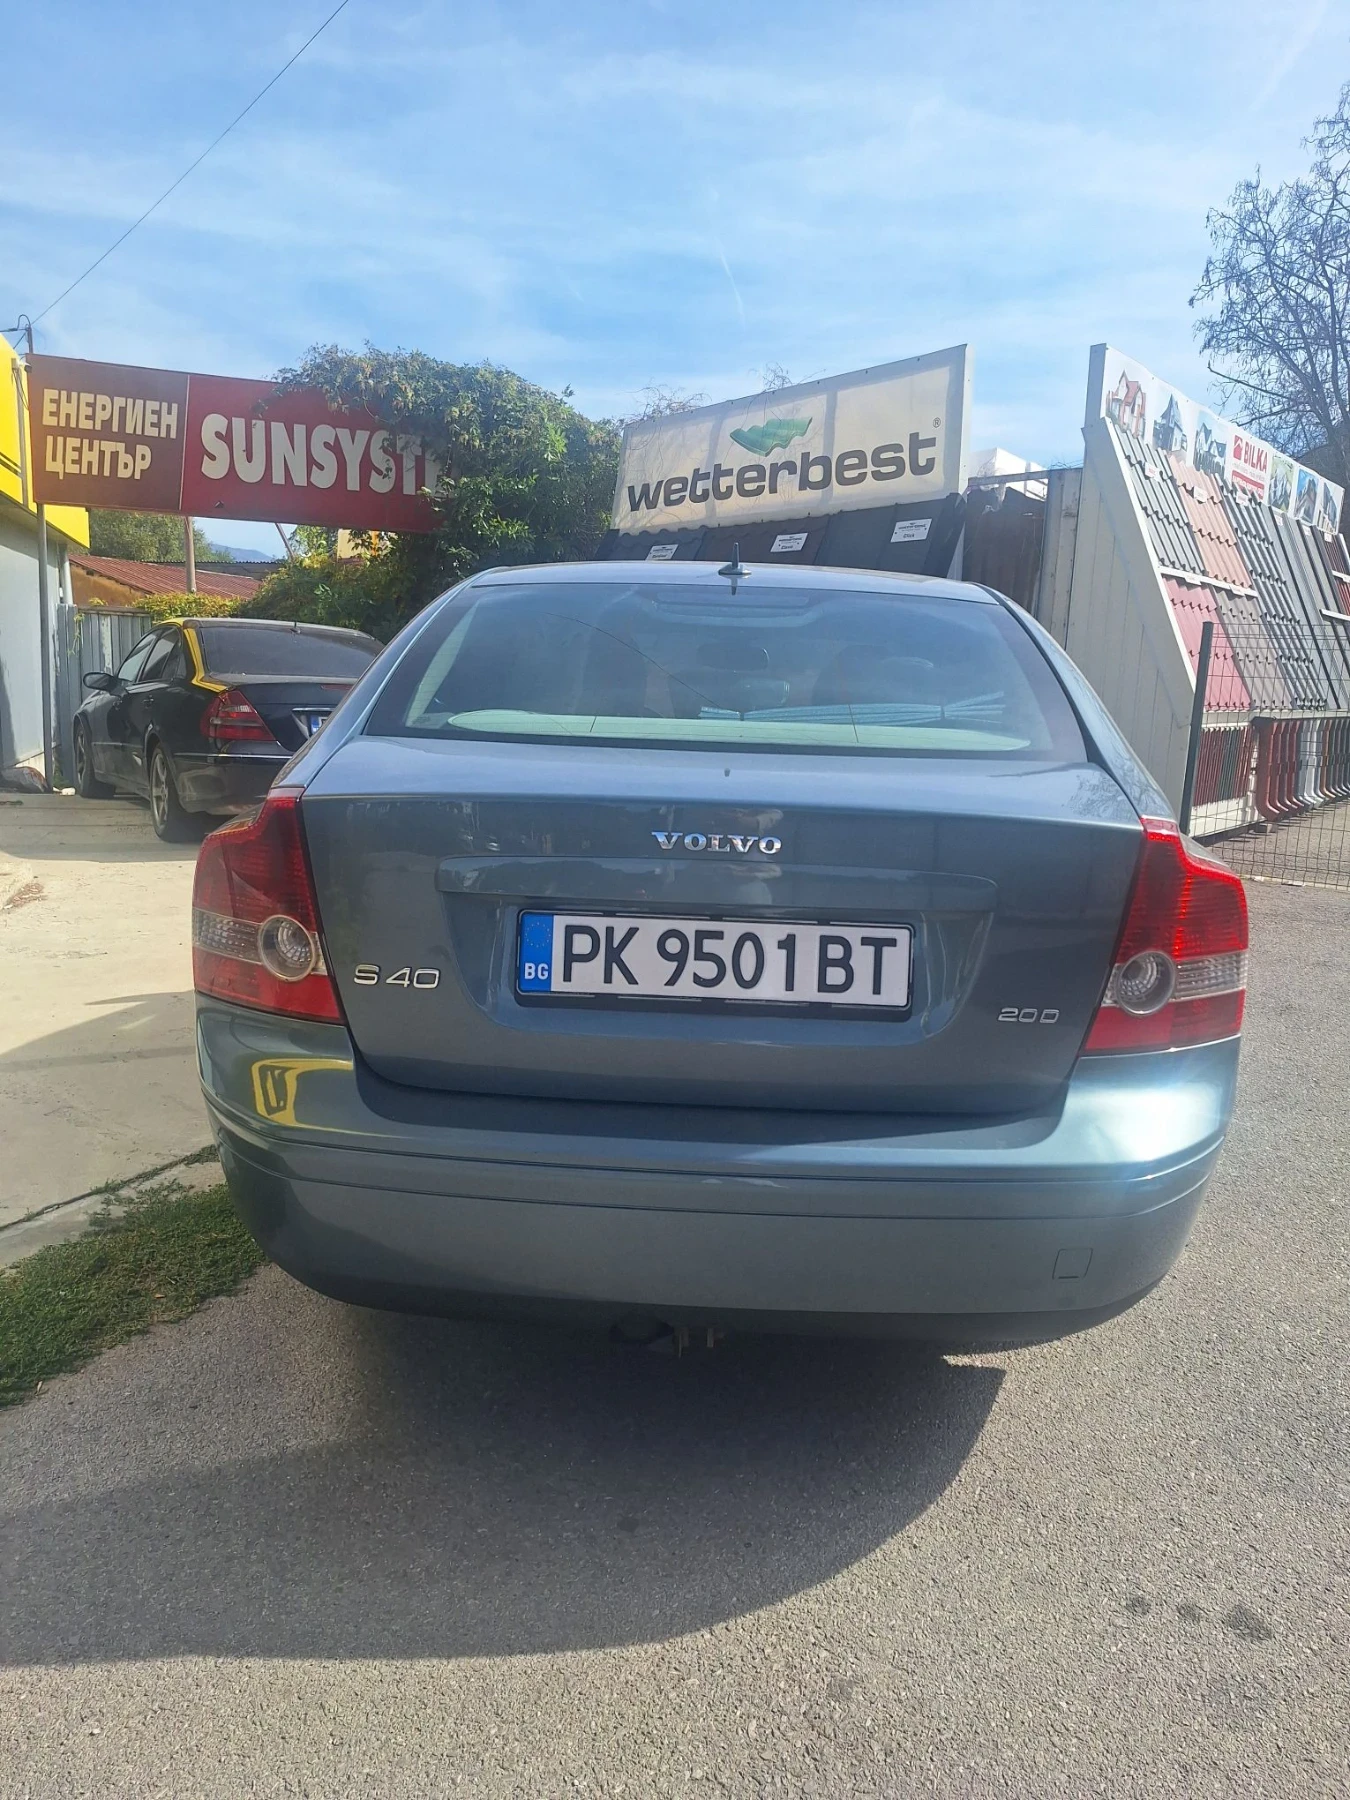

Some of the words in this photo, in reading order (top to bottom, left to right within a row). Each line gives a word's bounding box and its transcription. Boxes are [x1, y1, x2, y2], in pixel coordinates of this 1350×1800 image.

[42, 388, 178, 439] ЕНЕРГИЕН
[45, 434, 151, 480] ЦЕНТЪР
[627, 431, 937, 512] wetterbest
[1243, 441, 1268, 473] BILKA
[651, 831, 782, 855] VOLVO
[524, 962, 549, 980] BG
[562, 924, 640, 986] PK
[656, 928, 795, 992] 9501
[817, 934, 898, 996] BT
